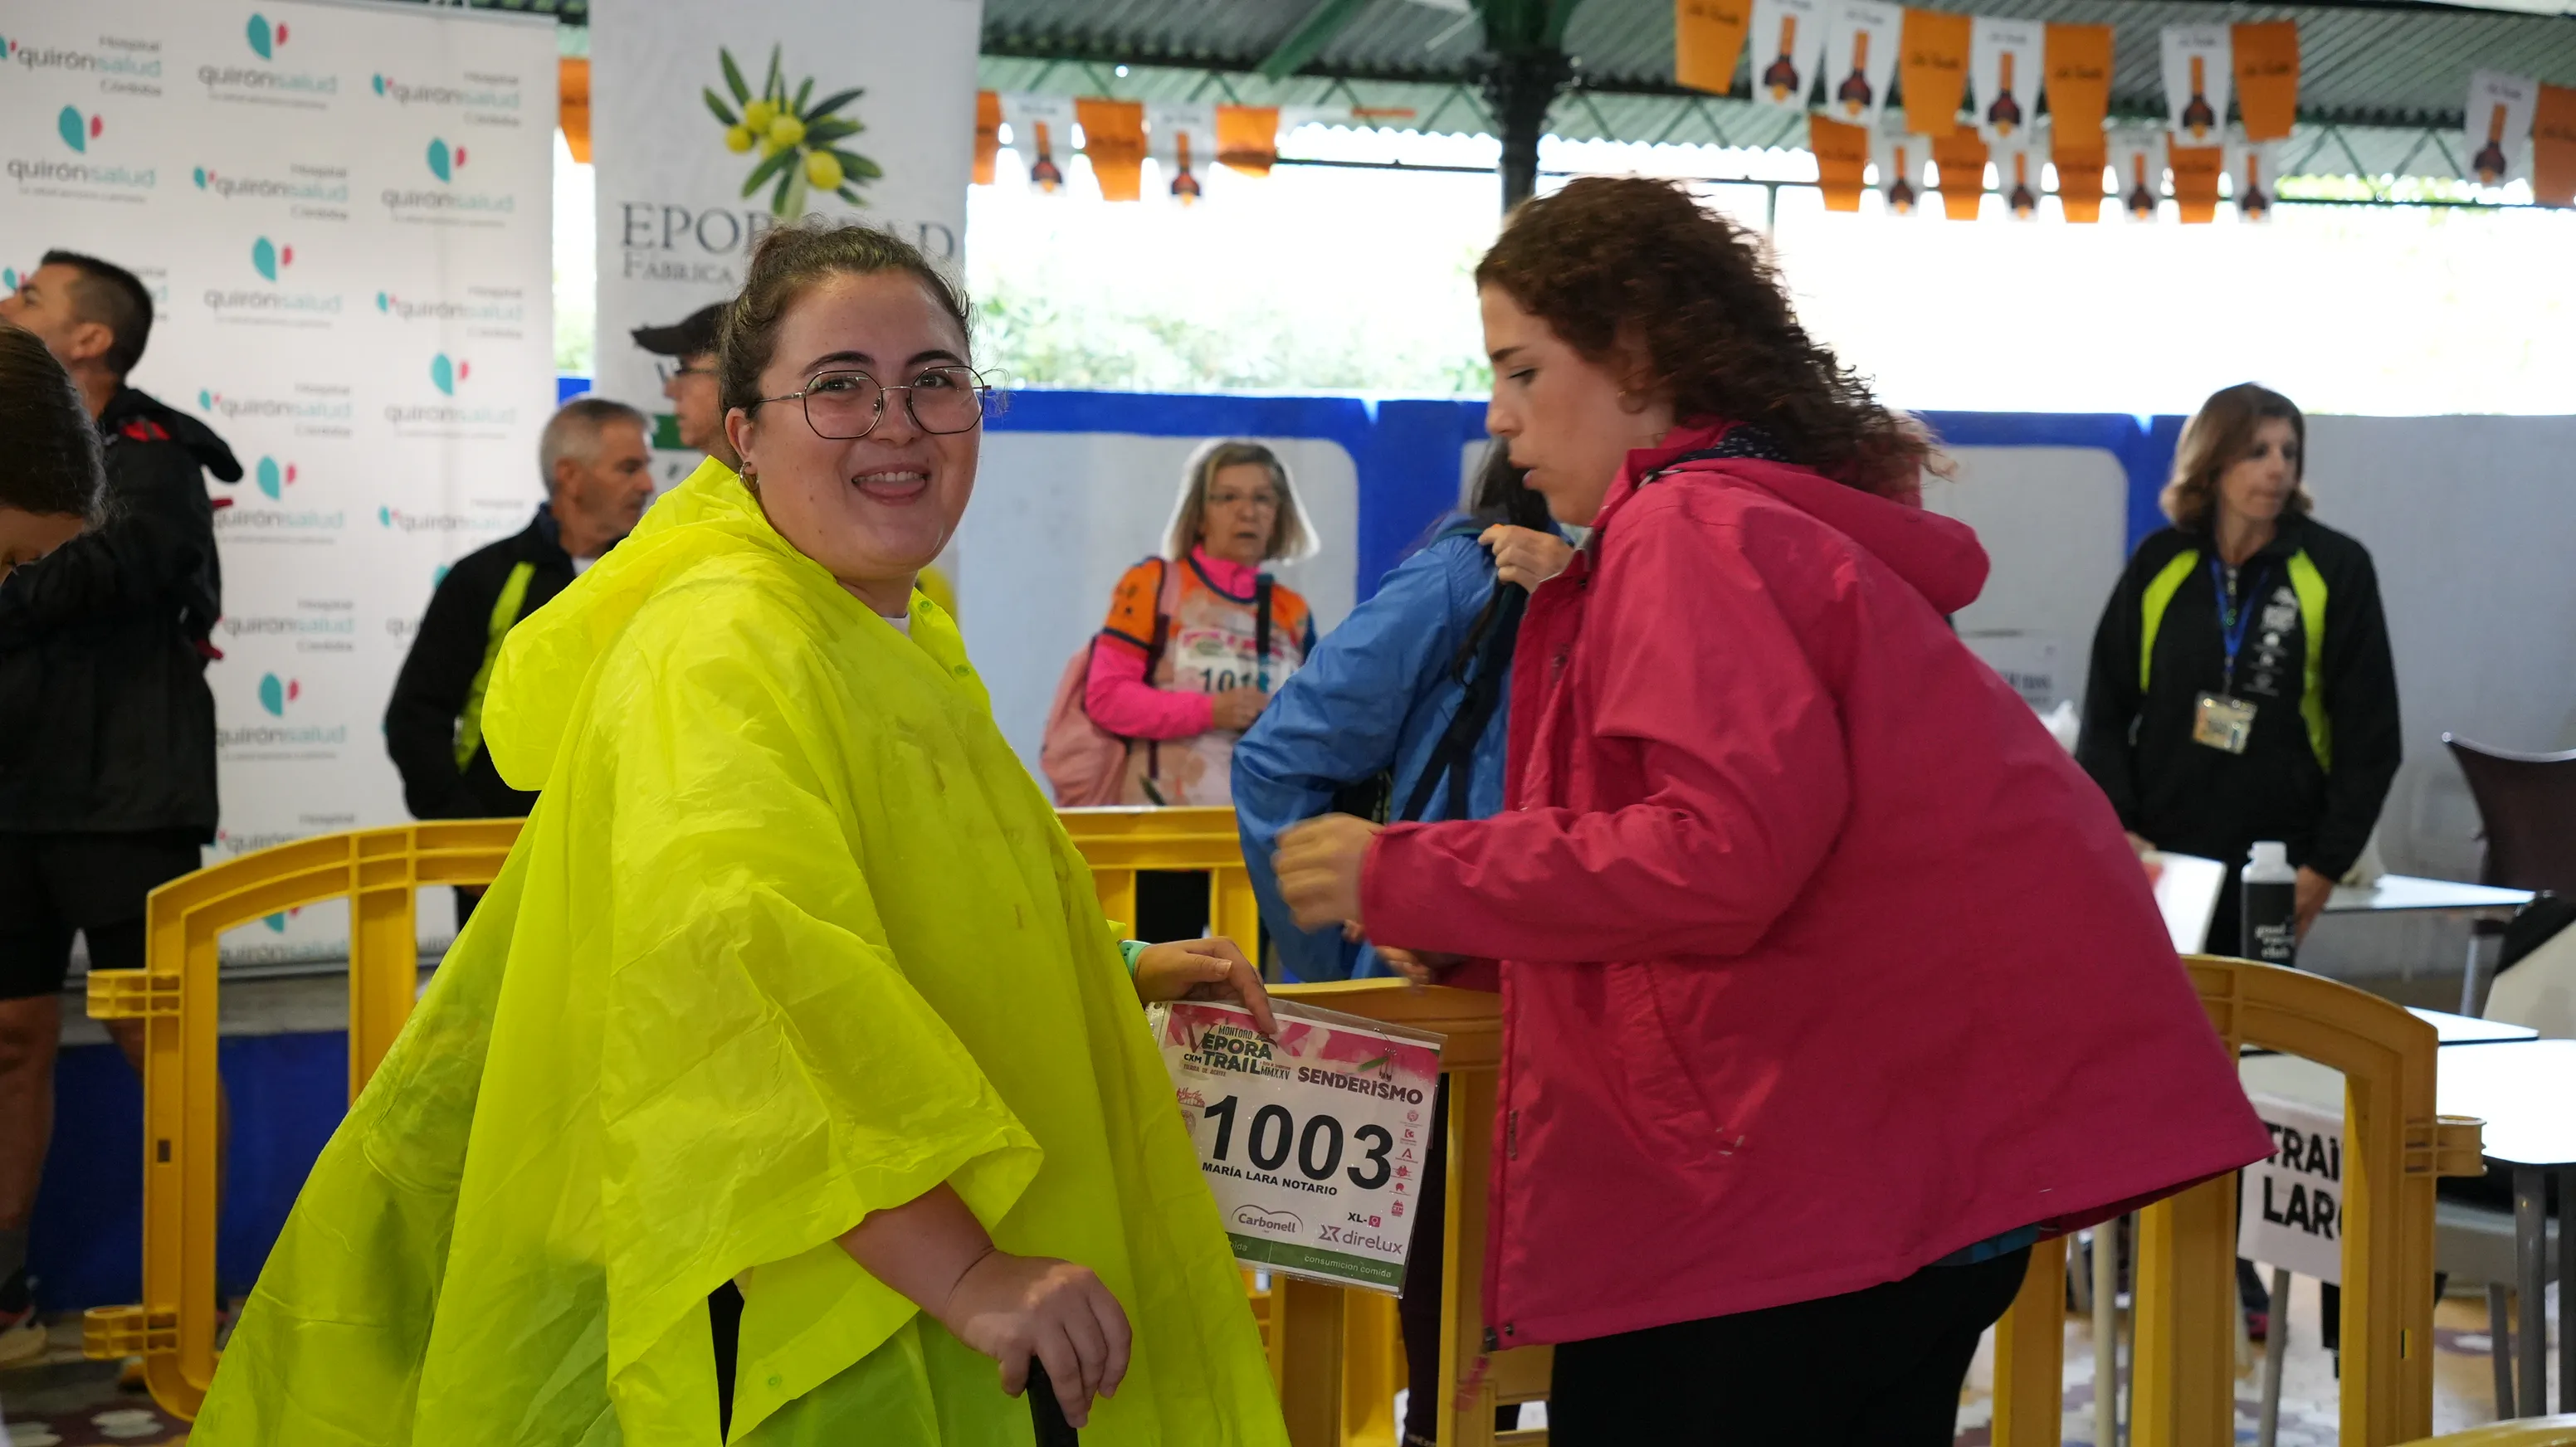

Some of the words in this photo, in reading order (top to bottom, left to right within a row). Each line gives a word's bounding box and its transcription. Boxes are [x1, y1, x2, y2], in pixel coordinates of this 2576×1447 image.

[1217, 1025, 1253, 1040] MONTORO
[1201, 1032, 1272, 1061] EPORA
[1183, 1053, 1202, 1064] CXM
[1202, 1050, 1261, 1075] TRAIL
[1260, 1065, 1290, 1080] MMXXV
[1298, 1066, 1423, 1105] SENDERISMO
[1203, 1094, 1394, 1190] 1003
[1202, 1162, 1242, 1178] MARÍA
[1246, 1171, 1278, 1185] LARA
[1282, 1178, 1338, 1196] NOTARIO
[2263, 1176, 2342, 1240] LAR
[1238, 1213, 1296, 1233] Carbonell
[1342, 1230, 1403, 1254] direlux
[1304, 1255, 1359, 1271] consumicion
[1360, 1265, 1392, 1279] comida
